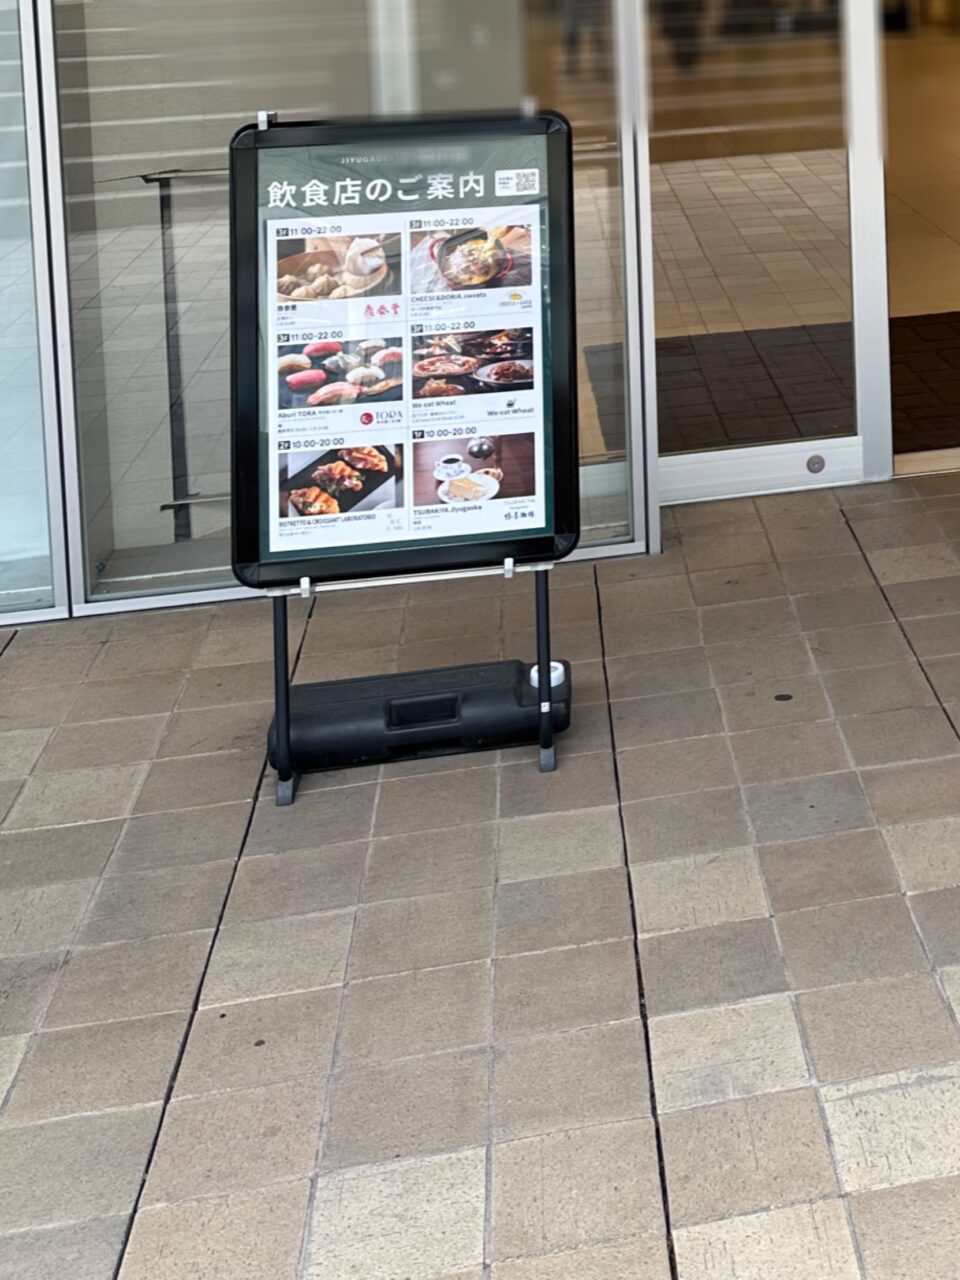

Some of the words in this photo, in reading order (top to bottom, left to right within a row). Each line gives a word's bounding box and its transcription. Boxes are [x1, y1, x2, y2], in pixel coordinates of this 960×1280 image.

[267, 171, 486, 209] 飲食店のご案内
